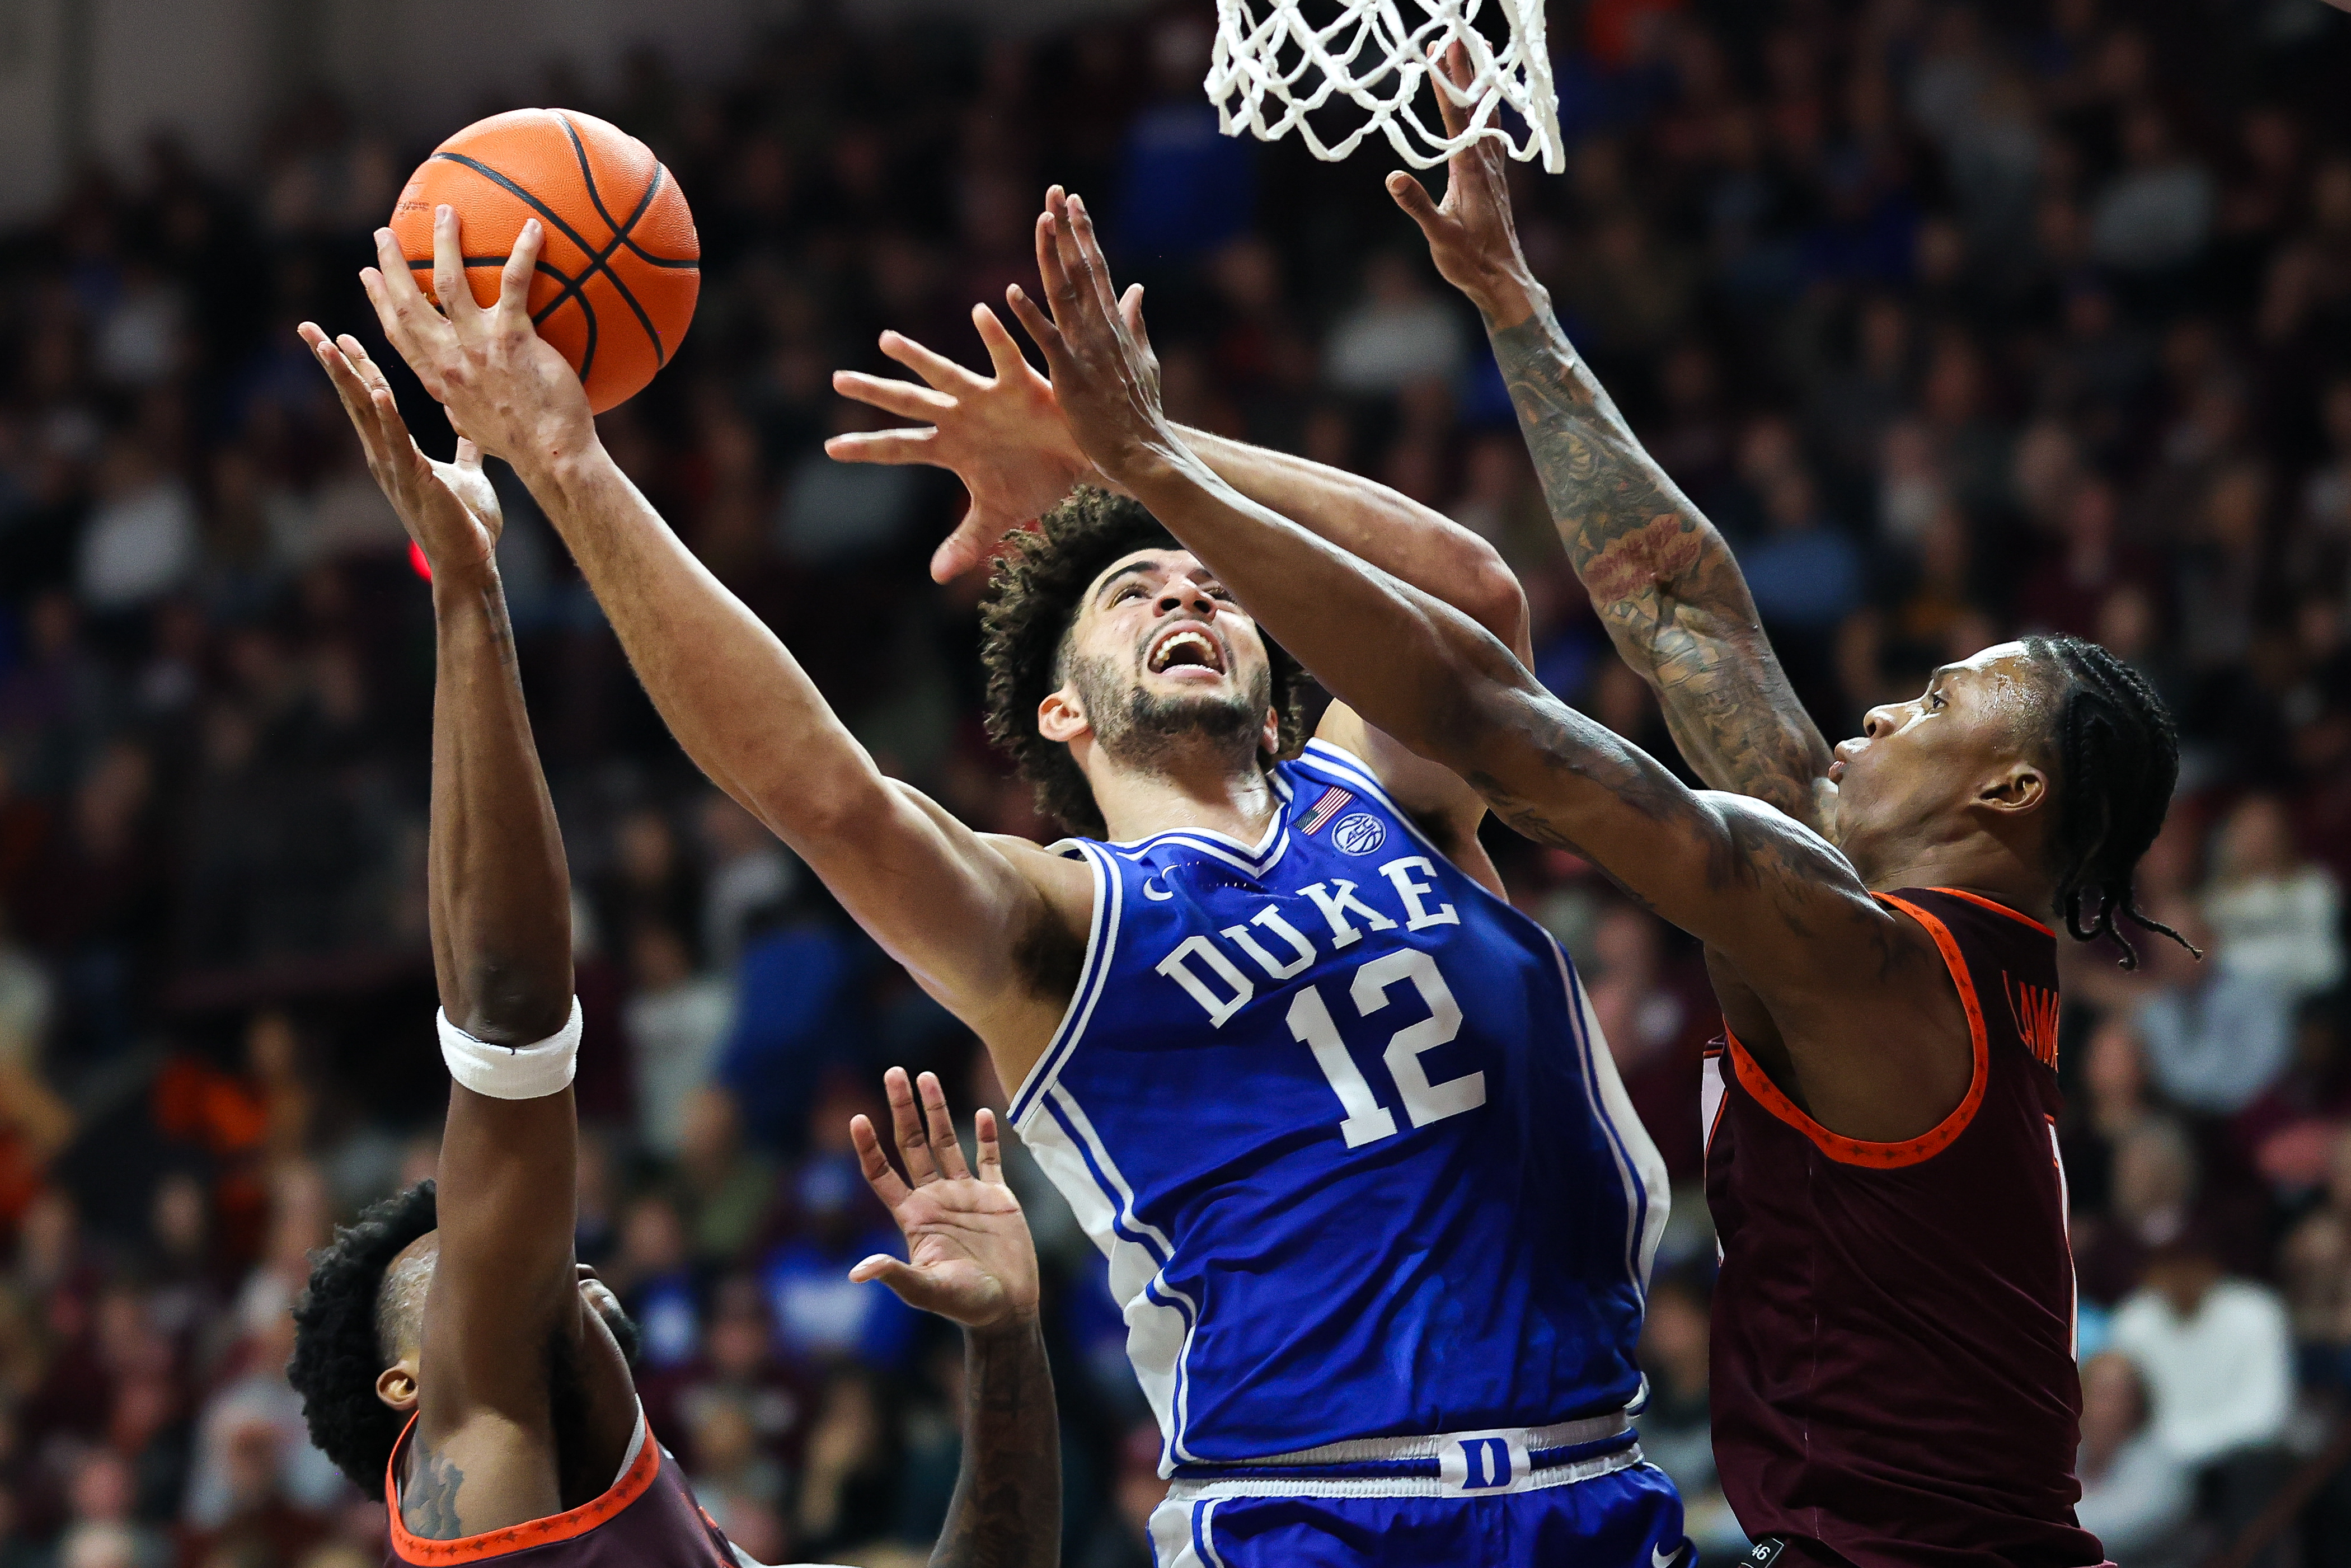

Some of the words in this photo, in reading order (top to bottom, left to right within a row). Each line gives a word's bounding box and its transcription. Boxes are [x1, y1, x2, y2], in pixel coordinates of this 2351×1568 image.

[1155, 856, 1460, 1029] DUKE
[1285, 948, 1486, 1149] 12
[1458, 1437, 1512, 1490] D
[1752, 1543, 1771, 1560] 46
